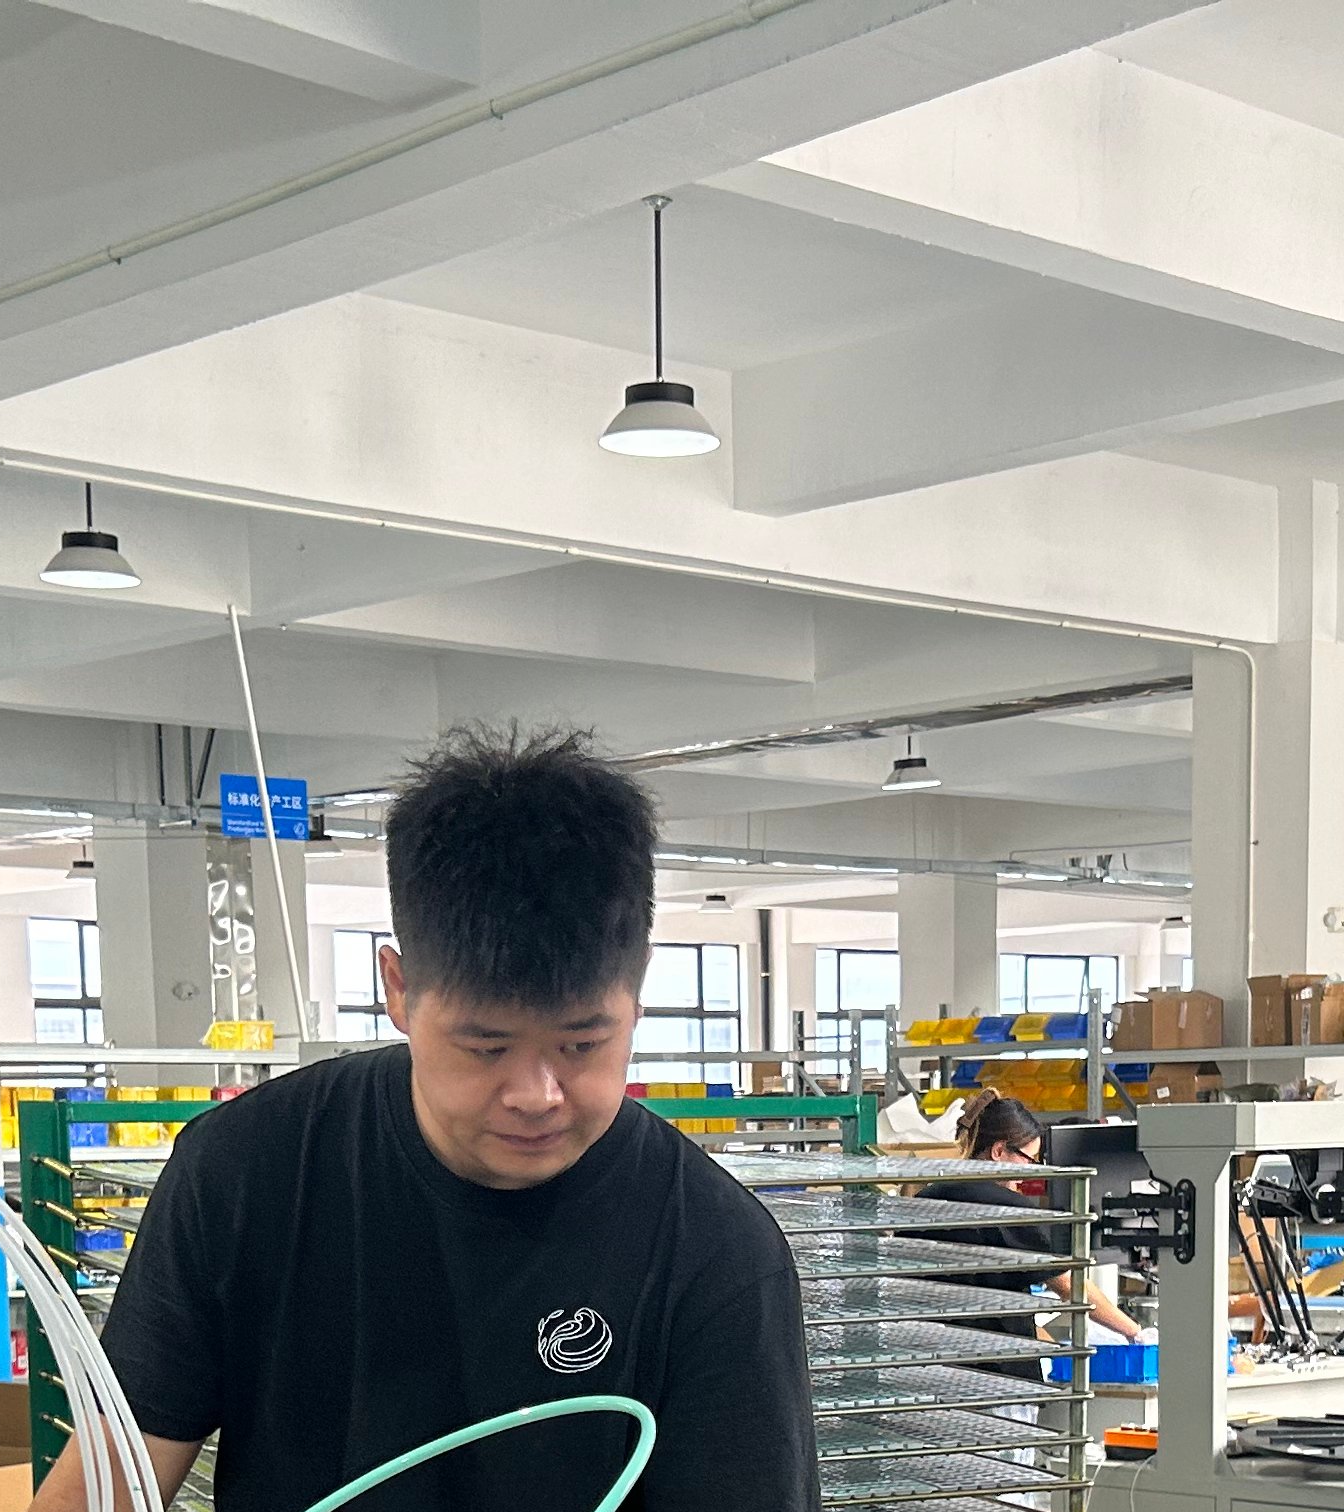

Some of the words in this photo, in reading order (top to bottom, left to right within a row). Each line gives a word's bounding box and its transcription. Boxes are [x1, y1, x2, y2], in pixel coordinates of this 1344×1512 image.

[227, 792, 303, 810] 标准化产工区
